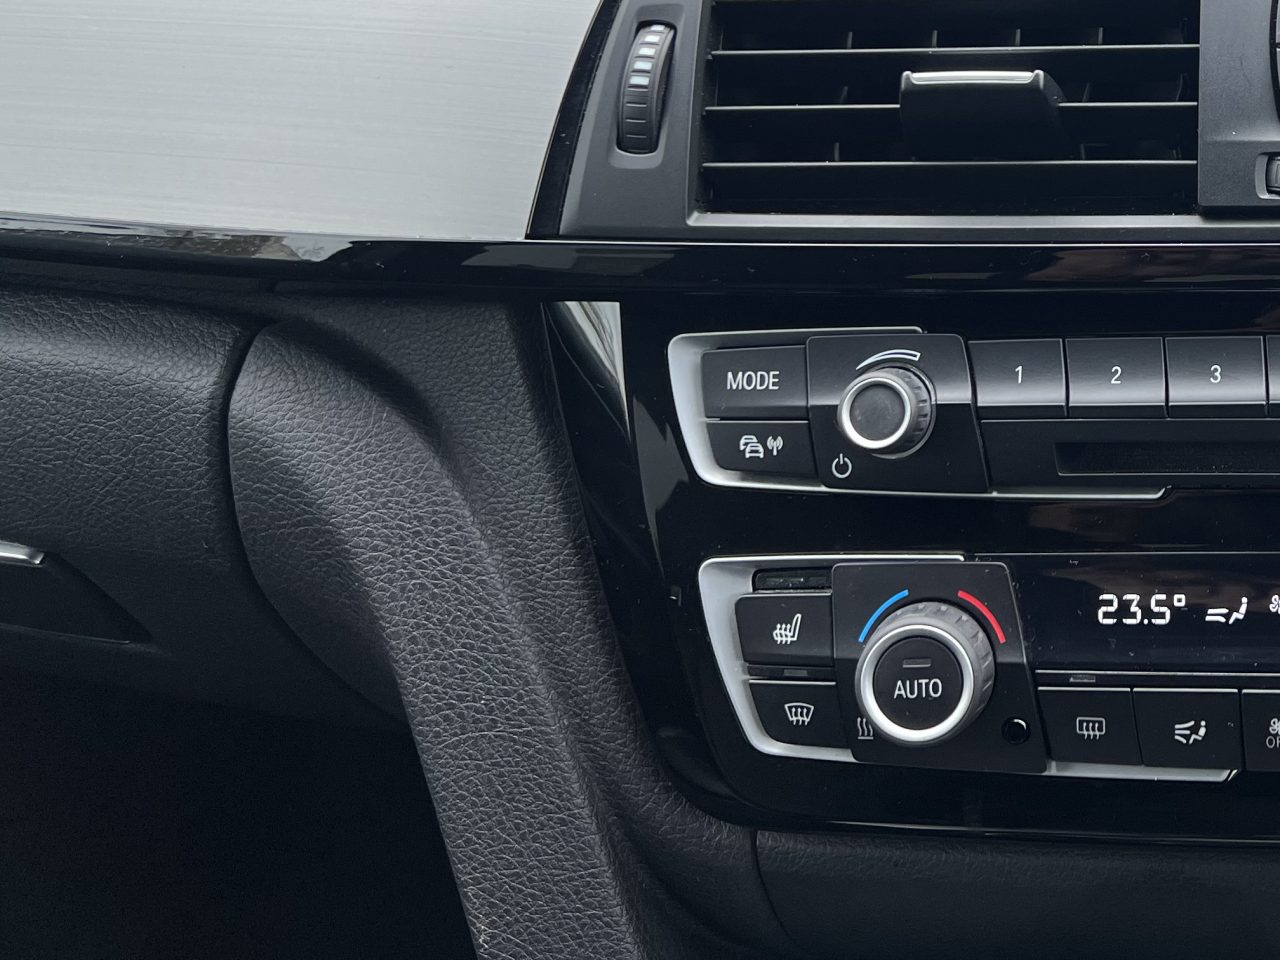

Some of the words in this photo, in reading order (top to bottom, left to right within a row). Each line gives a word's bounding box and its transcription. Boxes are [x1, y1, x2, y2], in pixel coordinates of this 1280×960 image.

[726, 370, 780, 391] MODE
[1014, 364, 1024, 385] 1
[1110, 366, 1122, 384] 2
[1210, 365, 1222, 383] 3
[893, 678, 943, 699] AUTO
